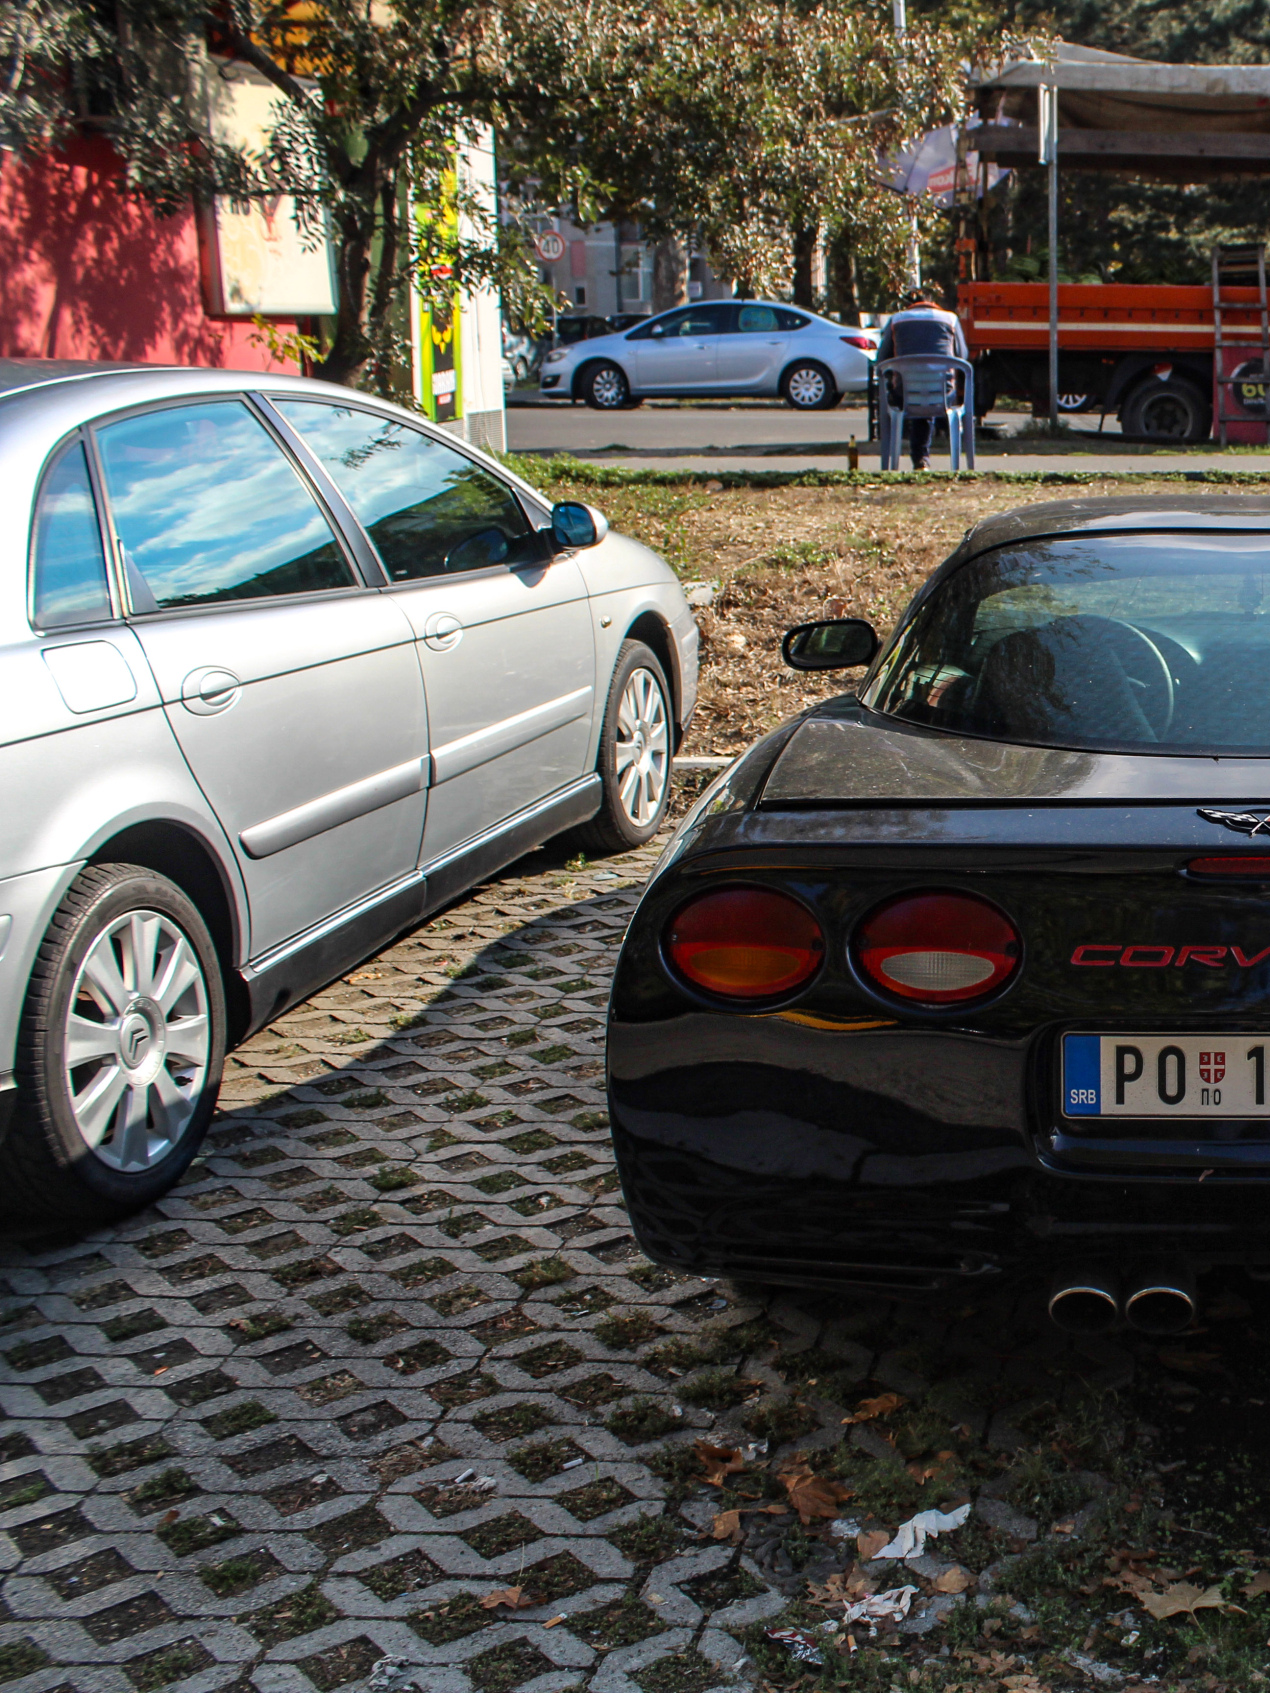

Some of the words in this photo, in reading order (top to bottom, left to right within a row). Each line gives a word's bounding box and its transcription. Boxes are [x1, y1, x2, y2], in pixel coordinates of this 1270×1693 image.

[542, 237, 559, 254] 40
[1115, 1044, 1186, 1105] PO
[1070, 1089, 1097, 1104] SRB
